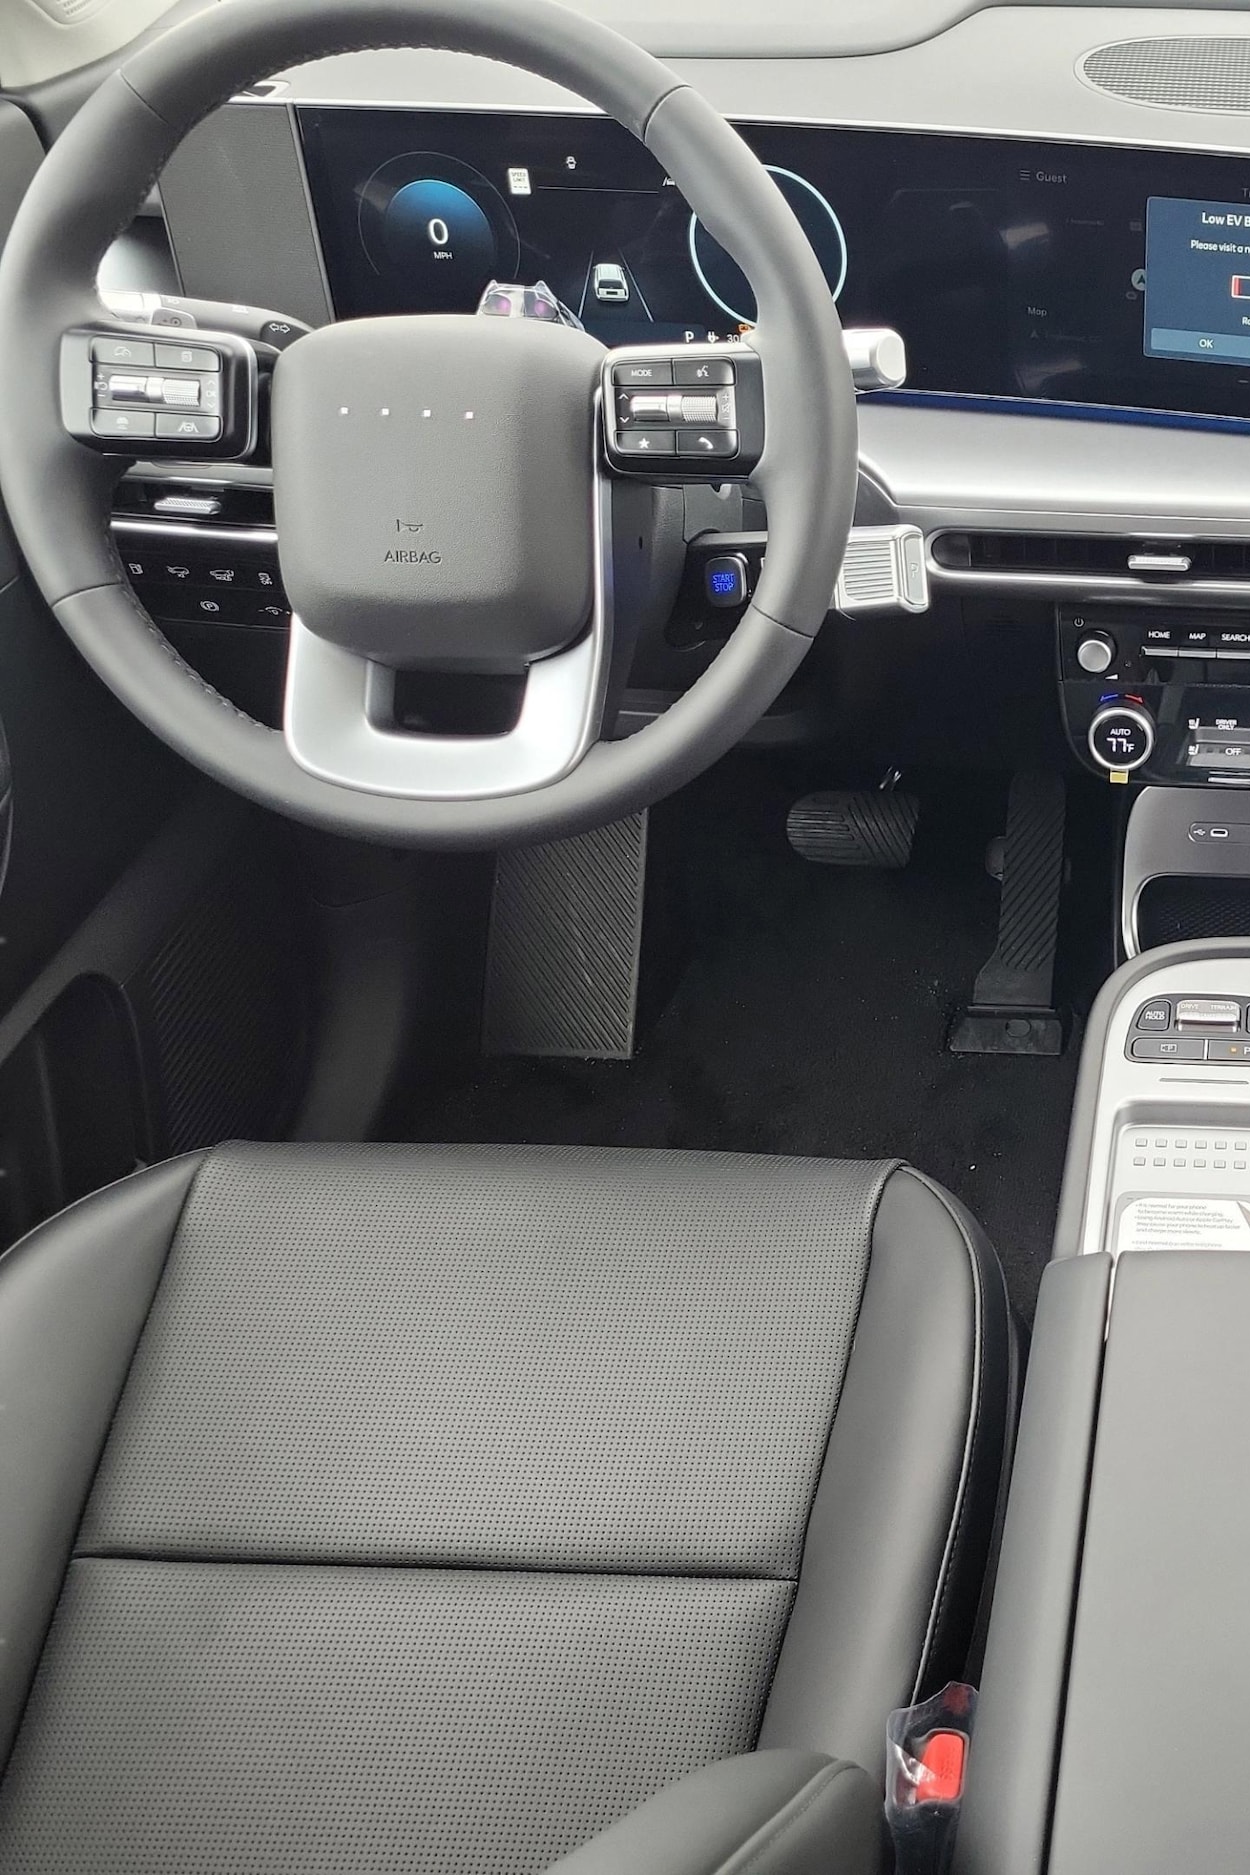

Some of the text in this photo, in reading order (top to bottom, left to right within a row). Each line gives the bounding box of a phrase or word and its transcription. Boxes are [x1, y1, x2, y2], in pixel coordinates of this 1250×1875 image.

[1036, 171, 1068, 184] Guest
[1202, 212, 1225, 225] Low
[1227, 214, 1243, 227] EV
[428, 218, 449, 244] 0
[1190, 239, 1218, 251] Please
[1219, 242, 1236, 253] visit
[1237, 246, 1244, 254] a
[433, 251, 453, 260] MPH
[1027, 306, 1047, 317] Map
[685, 331, 694, 343] P
[1199, 339, 1213, 349] OK
[631, 369, 653, 377] MODE
[384, 550, 442, 564] AIRBAG
[712, 573, 734, 583] START
[715, 583, 734, 592] STOP
[1148, 631, 1171, 639] HOME
[1221, 633, 1250, 642] SEARCH
[1110, 728, 1131, 736] AUTO
[1225, 747, 1242, 756] OFF
